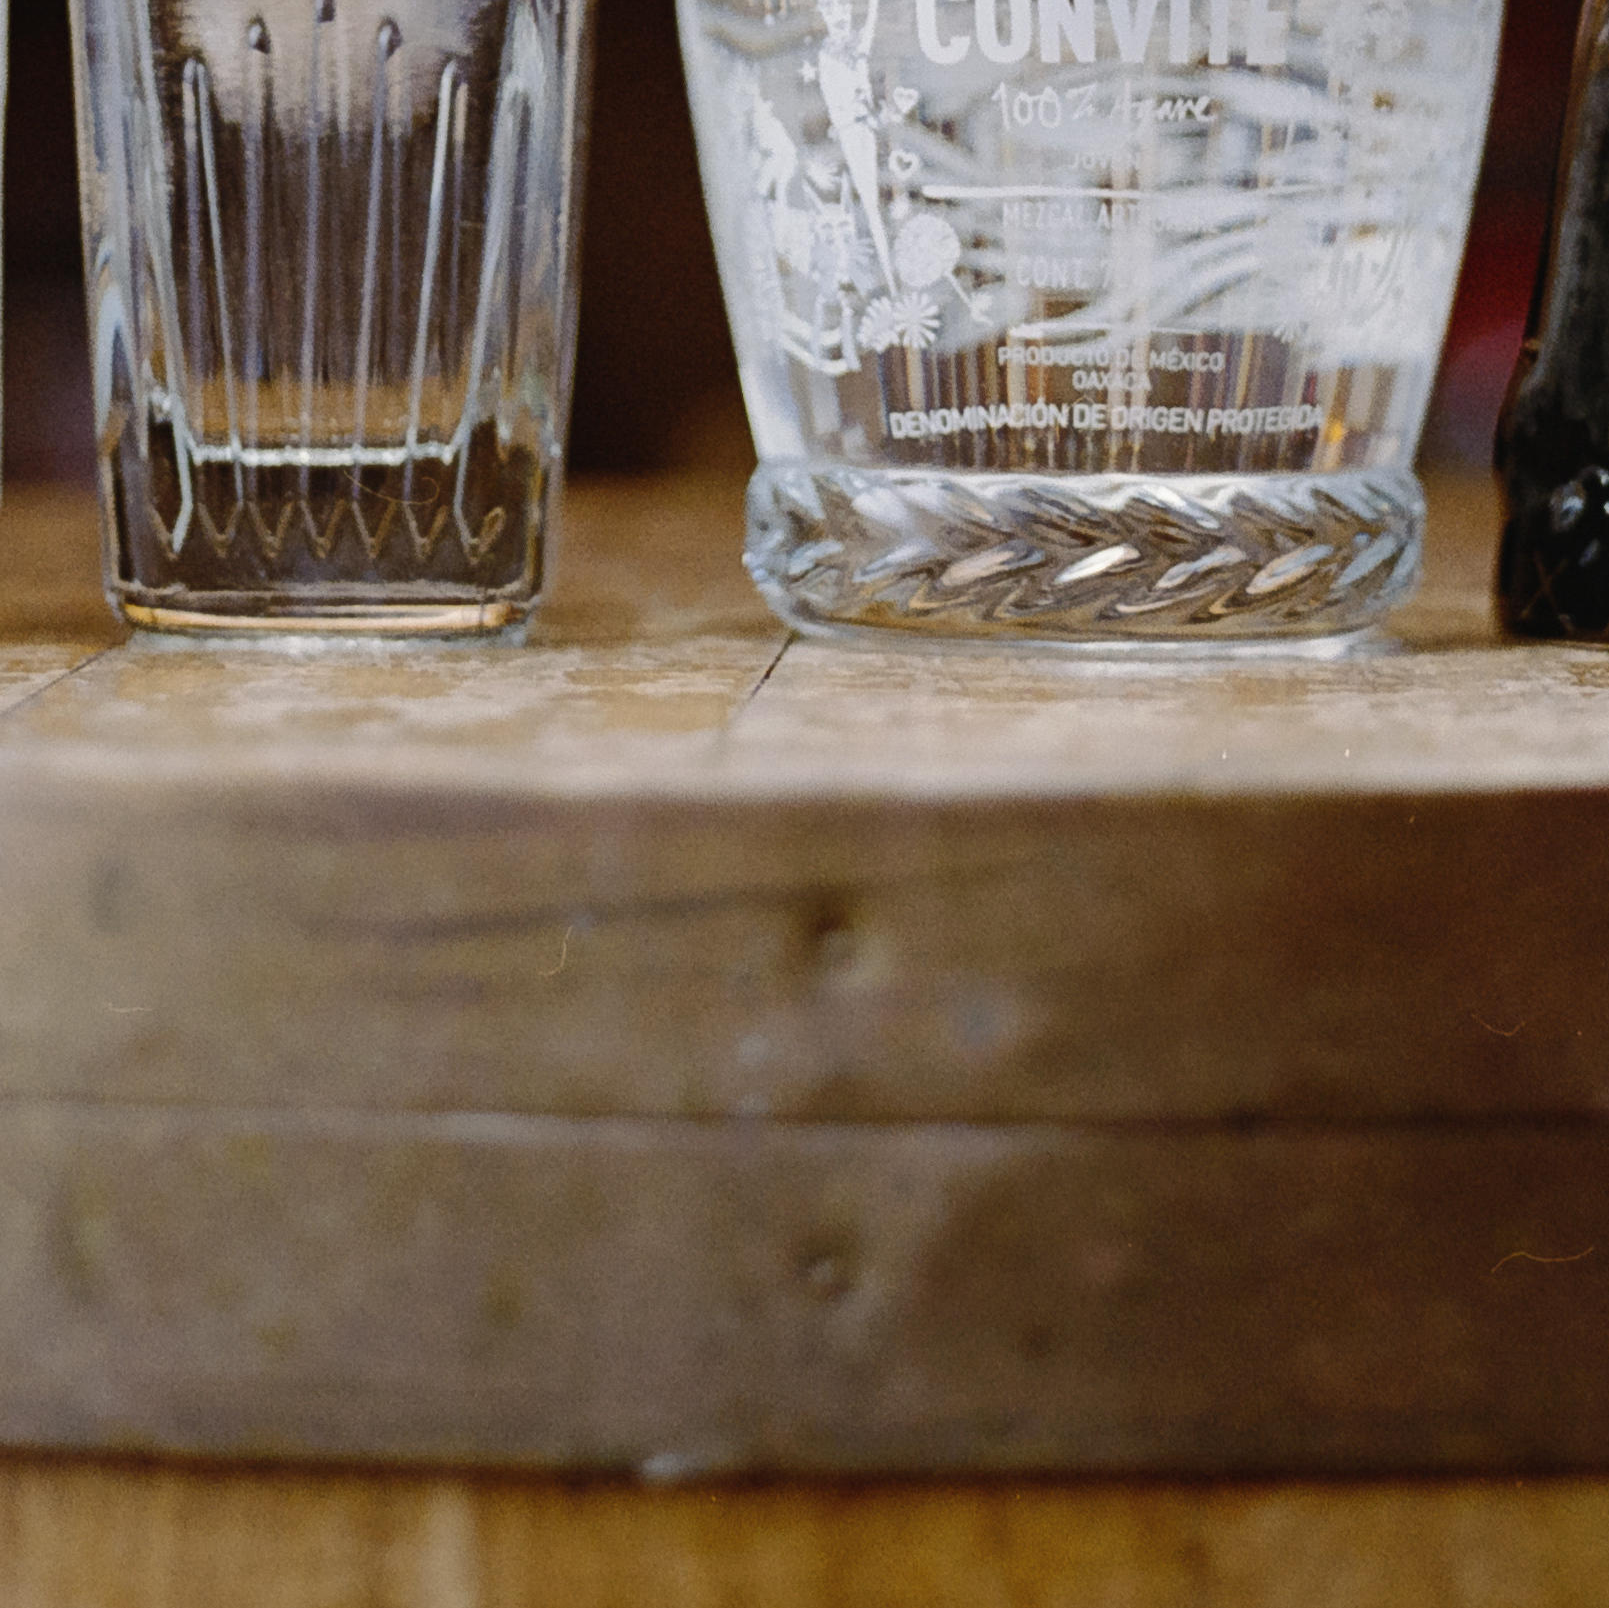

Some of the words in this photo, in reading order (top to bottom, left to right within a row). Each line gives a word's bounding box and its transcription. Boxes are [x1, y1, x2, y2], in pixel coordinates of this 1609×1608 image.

[997, 346, 1110, 368] PRODUCTO
[1148, 347, 1224, 373] MÉXICO
[1072, 371, 1154, 392] OAXACA
[889, 399, 1070, 440] DENOMINACIÓN
[1072, 403, 1109, 432] DE
[1111, 404, 1205, 433] ORIGEN
[1207, 405, 1325, 435] PROTEGIDA
